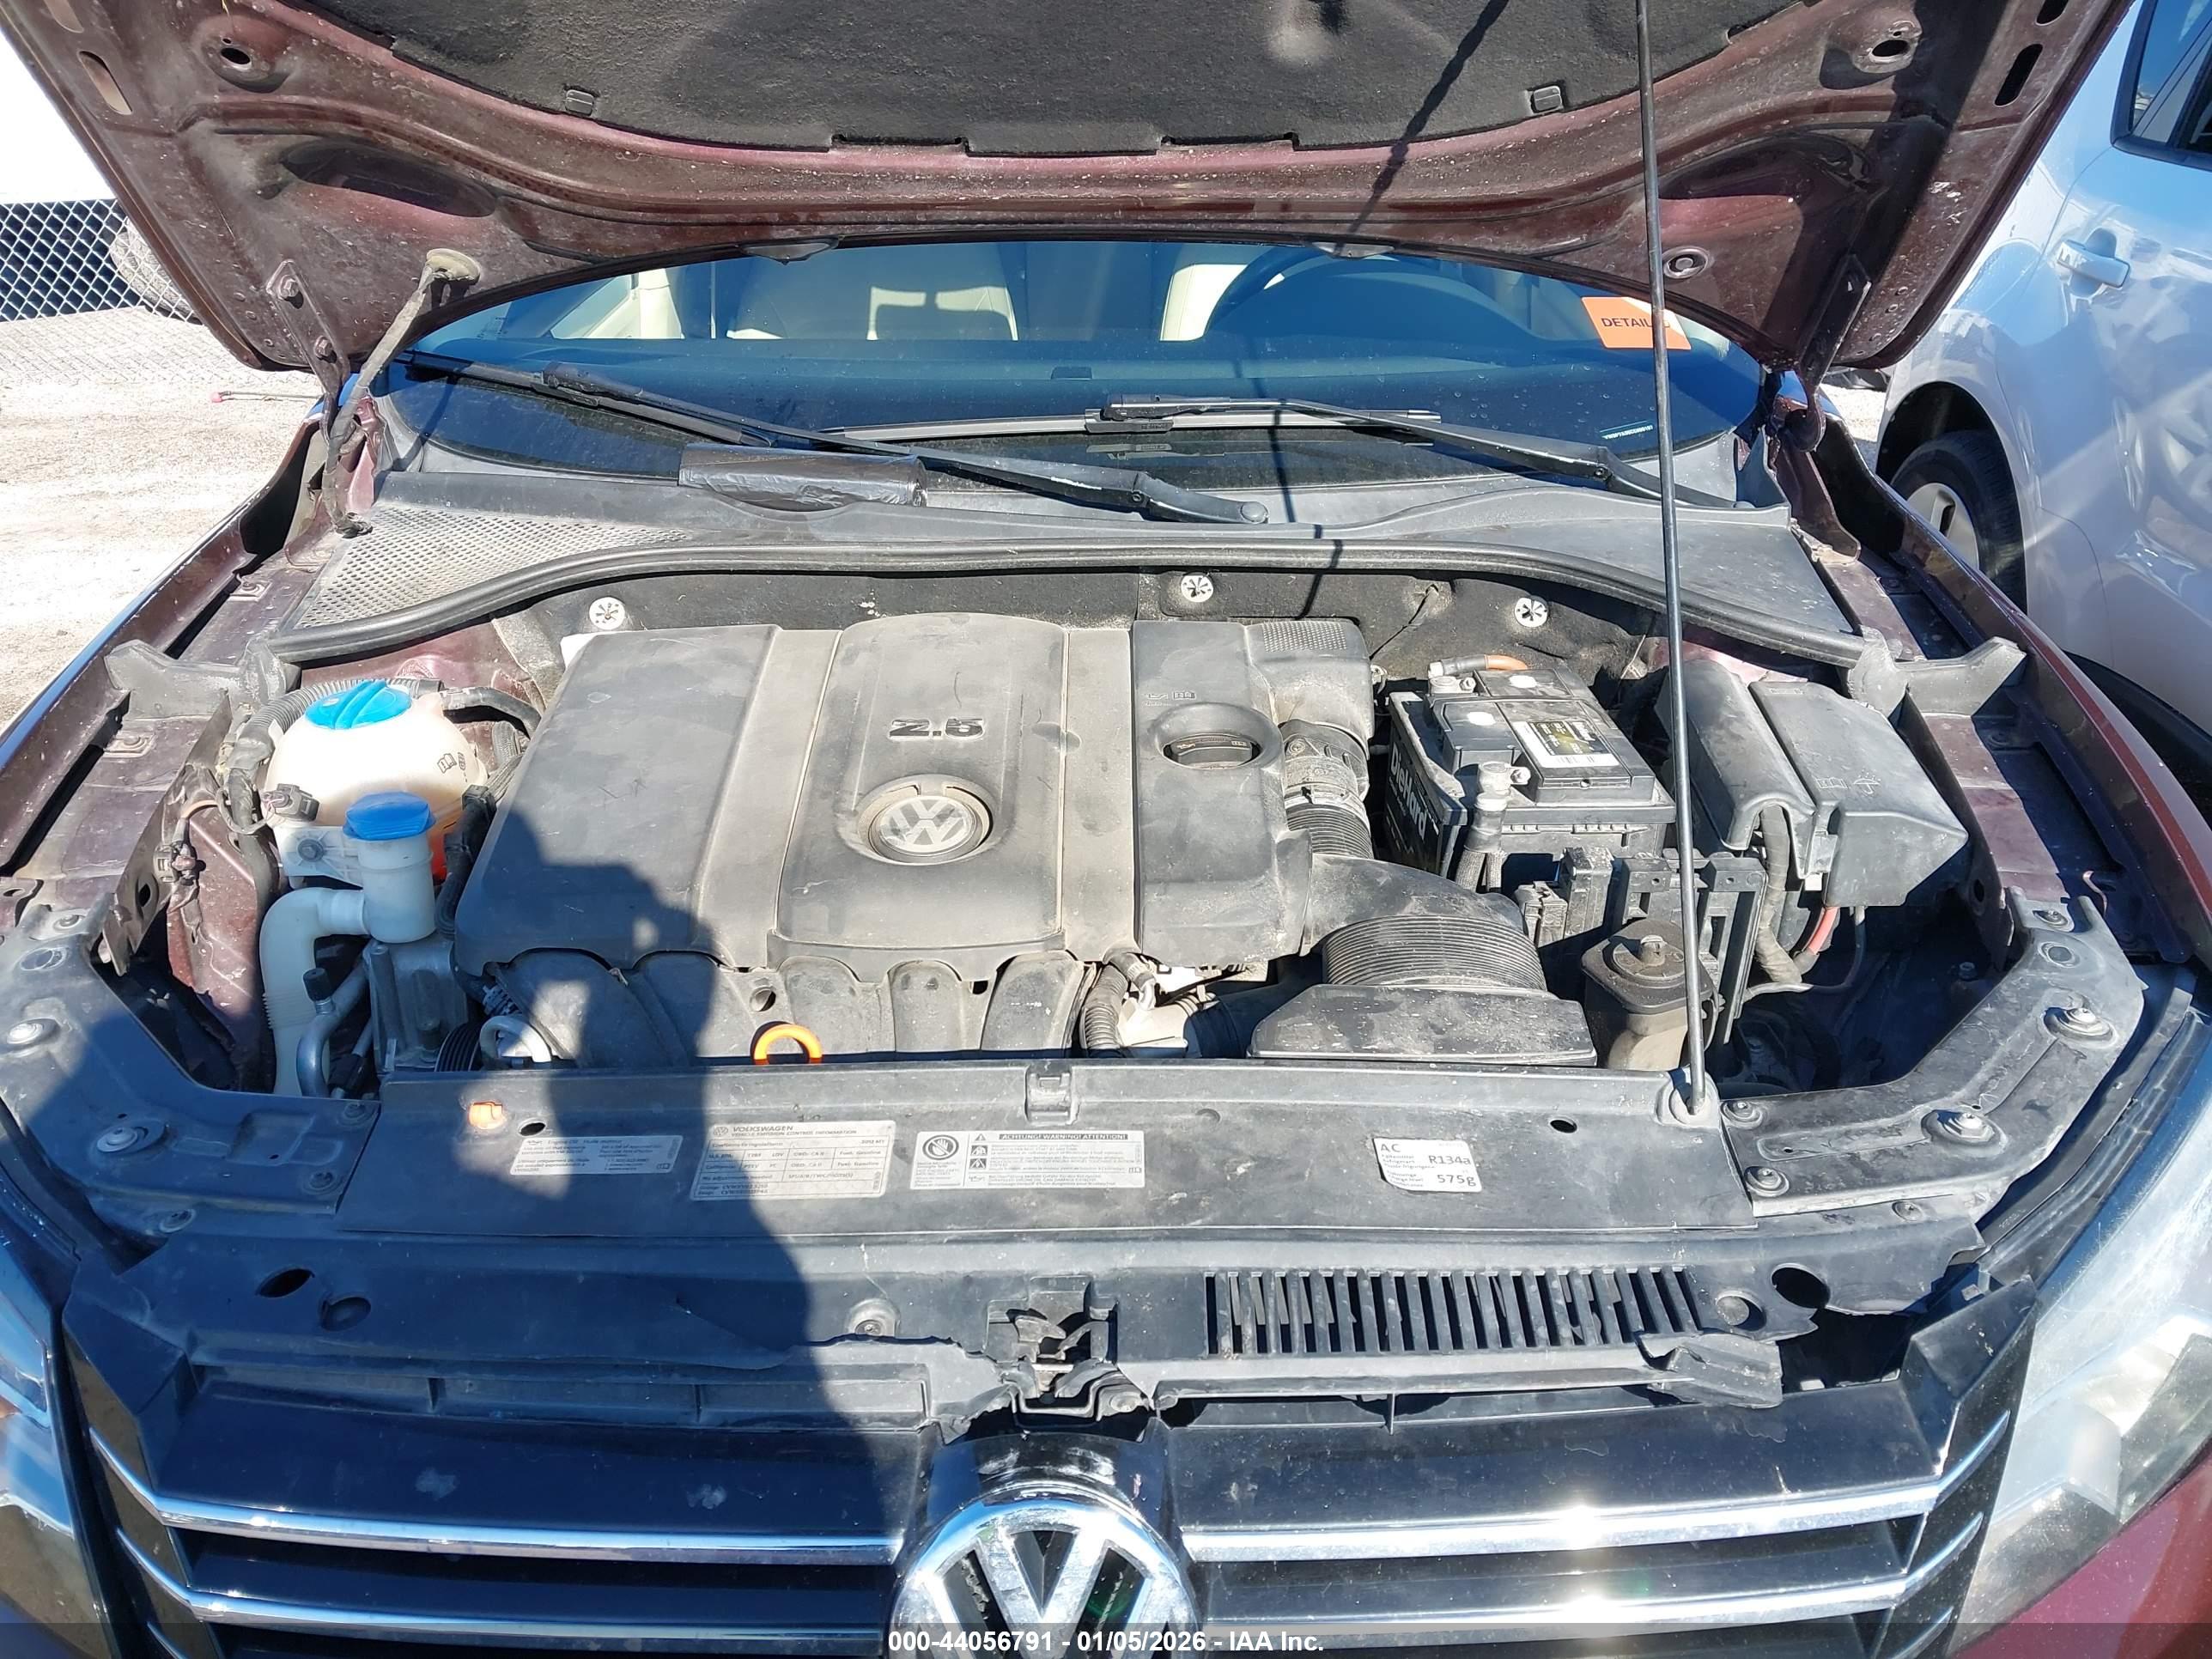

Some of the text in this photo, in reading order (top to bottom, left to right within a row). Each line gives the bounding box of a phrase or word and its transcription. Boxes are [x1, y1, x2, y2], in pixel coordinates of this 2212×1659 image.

[888, 718, 985, 738] 2.5
[1390, 741, 1428, 841] DieHard
[1428, 1155, 1471, 1165] R134a
[1437, 1174, 1477, 1187] 575g
